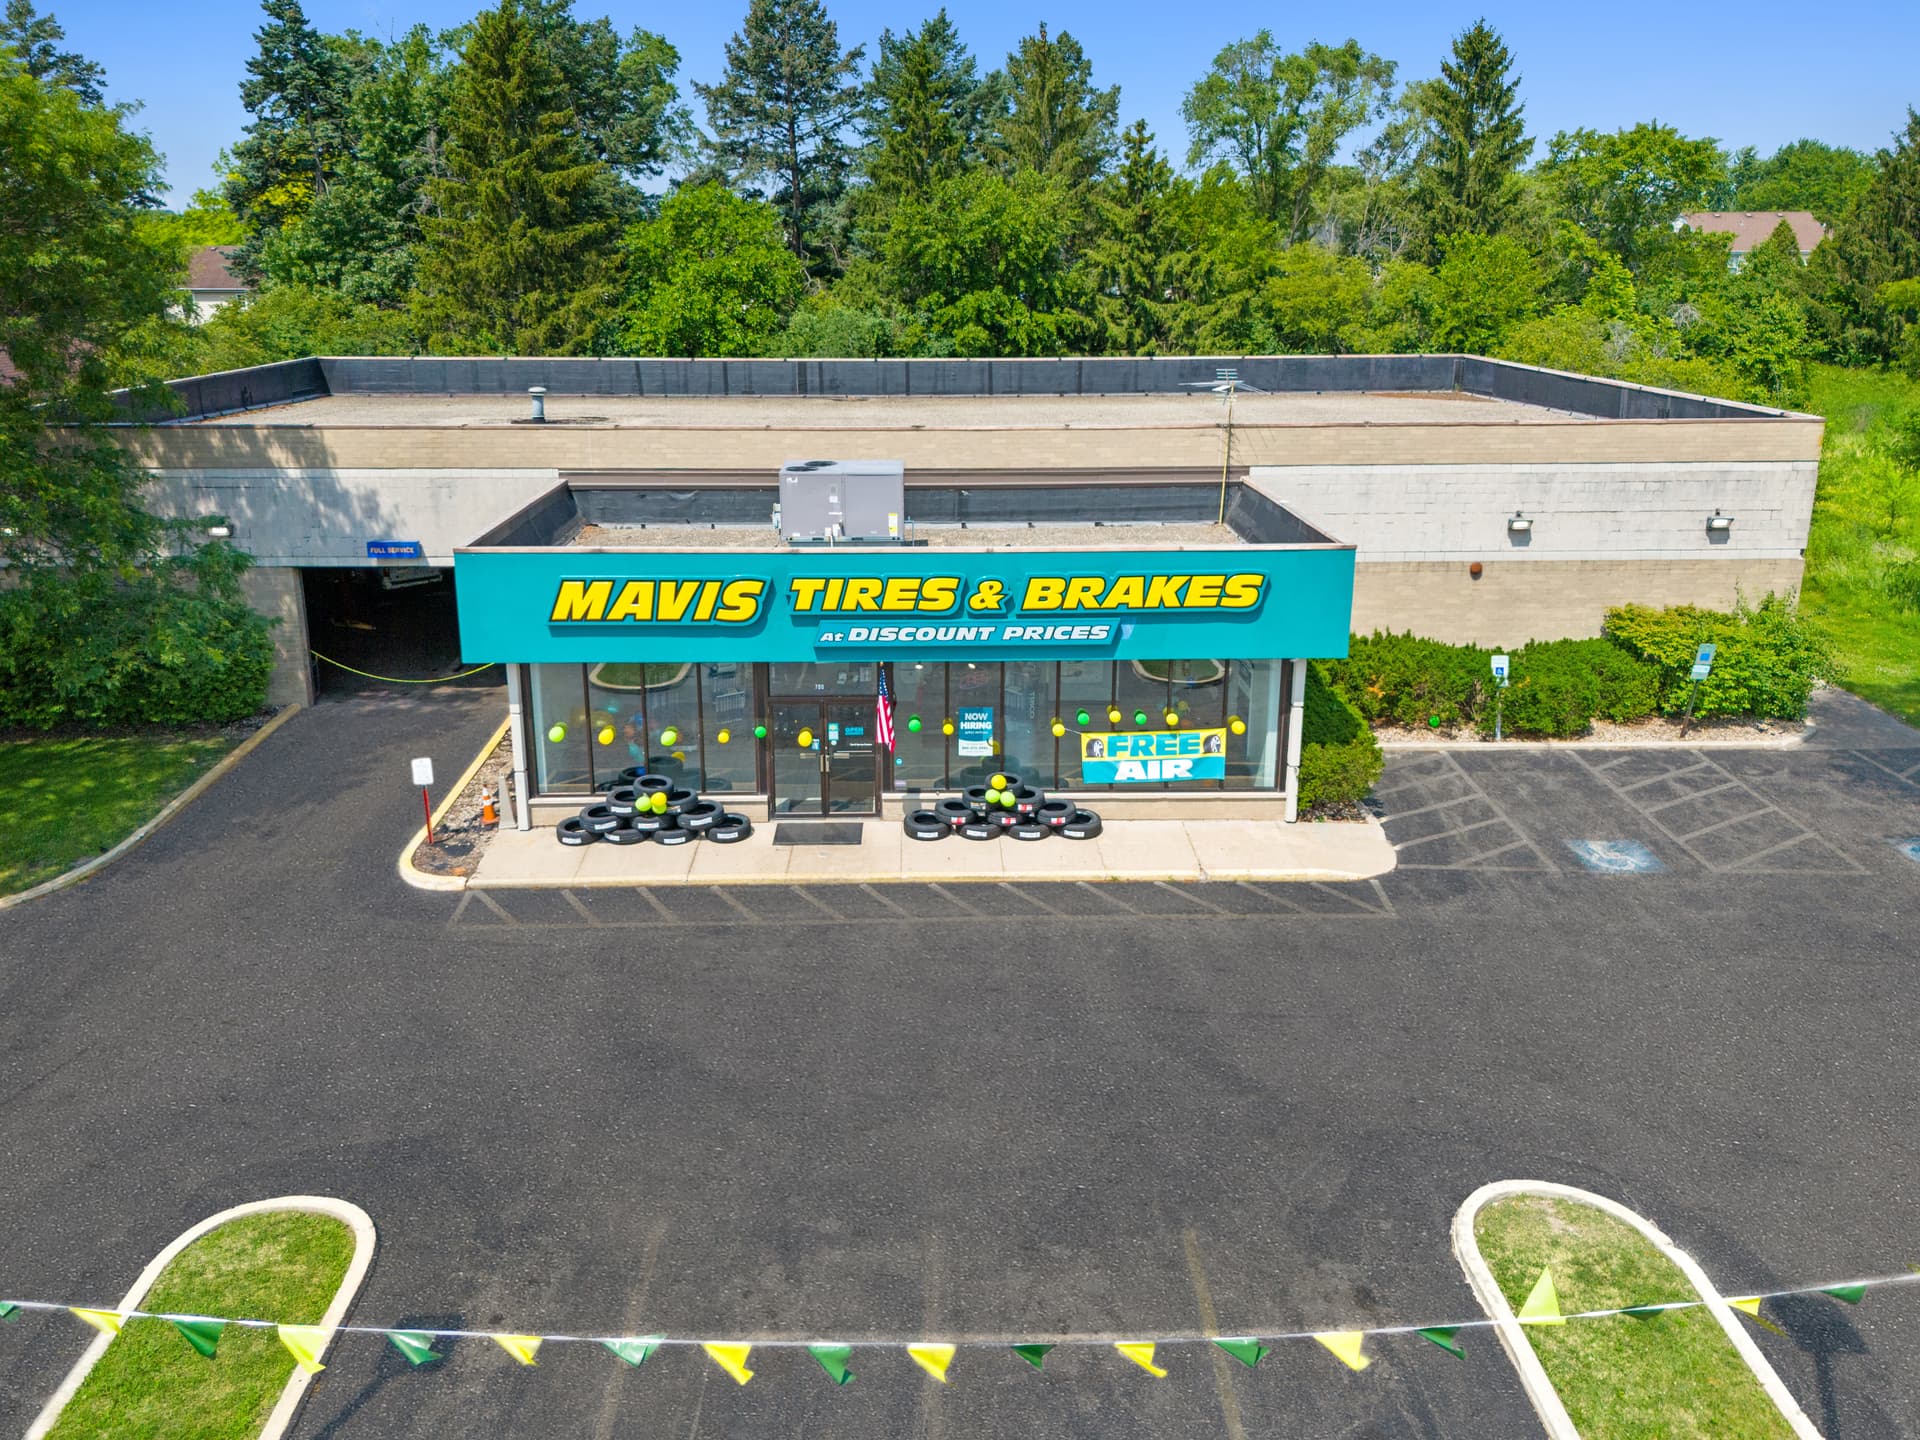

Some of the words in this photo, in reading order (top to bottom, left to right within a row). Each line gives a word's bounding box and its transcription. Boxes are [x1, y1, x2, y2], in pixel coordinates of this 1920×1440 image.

[550, 579, 765, 622] MAVIS
[790, 577, 960, 612] TIRES
[968, 580, 1005, 611] &
[1021, 573, 1265, 611] BRAKES
[820, 632, 844, 642] At
[847, 626, 996, 641] DISCOUNT
[1002, 625, 1110, 640] PRICES
[960, 721, 993, 730] HIRING
[964, 712, 989, 721] NOW
[1107, 732, 1201, 758] FREE
[1114, 758, 1194, 781] AIR
